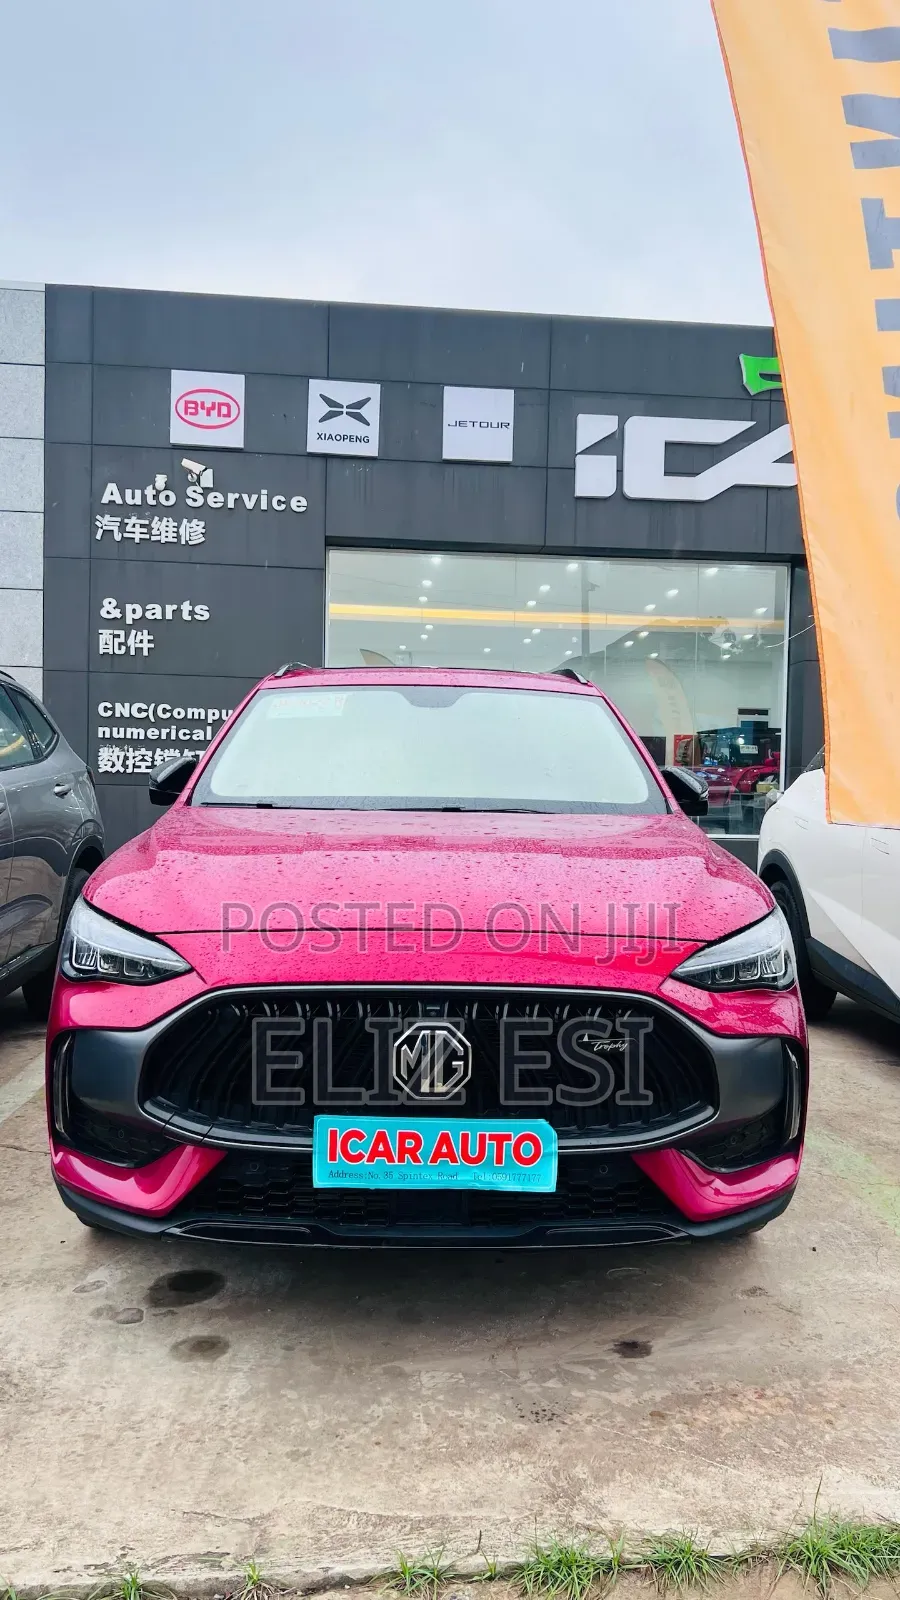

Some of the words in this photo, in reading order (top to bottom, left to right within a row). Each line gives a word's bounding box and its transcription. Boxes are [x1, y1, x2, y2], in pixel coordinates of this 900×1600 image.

[183, 399, 232, 418] BYD
[447, 420, 510, 429] JETOUR
[316, 432, 370, 444] XIAOPENG
[101, 482, 177, 506] Auto
[185, 485, 308, 512] Service
[94, 514, 206, 545] 汽车维修
[98, 629, 155, 656] 配件
[97, 725, 212, 741] numerical
[590, 1040, 630, 1052] Trophy
[399, 1029, 465, 1094] MG
[327, 1128, 424, 1166] ICAR
[427, 1131, 543, 1167] AUTO
